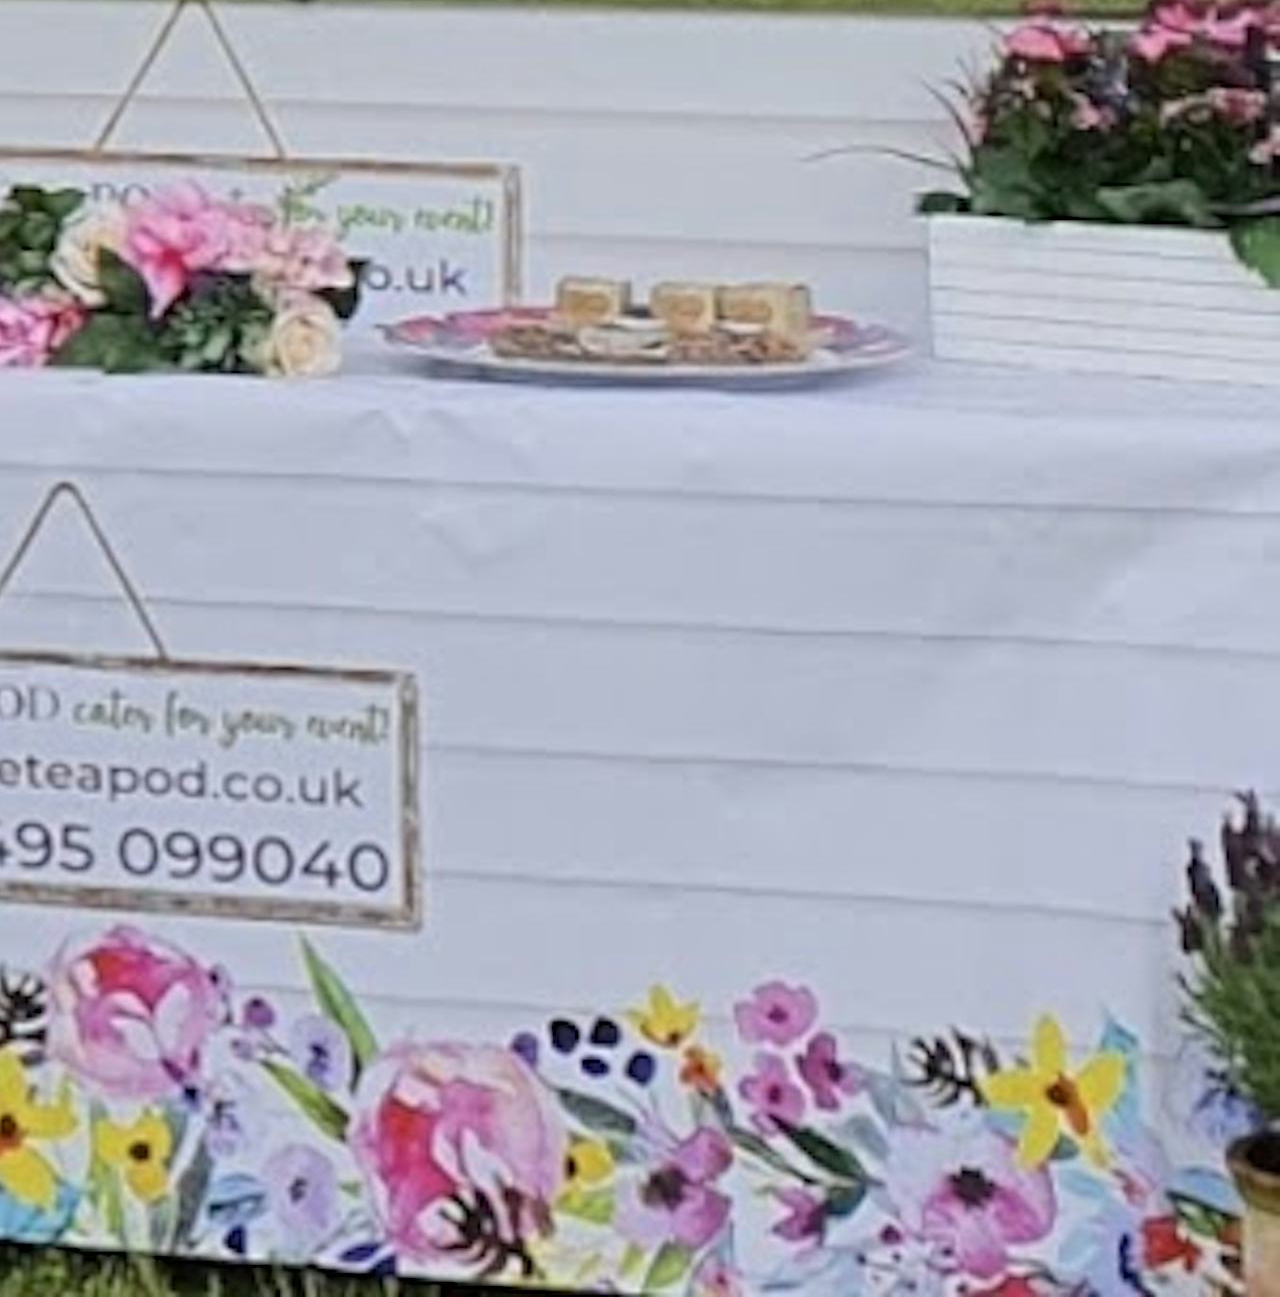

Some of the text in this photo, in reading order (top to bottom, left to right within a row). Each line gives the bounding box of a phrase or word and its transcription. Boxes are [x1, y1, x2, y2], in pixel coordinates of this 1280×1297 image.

[72, 689, 152, 734] cater
[164, 689, 211, 737] for
[218, 708, 296, 749] your
[119, 826, 390, 893] 099040
